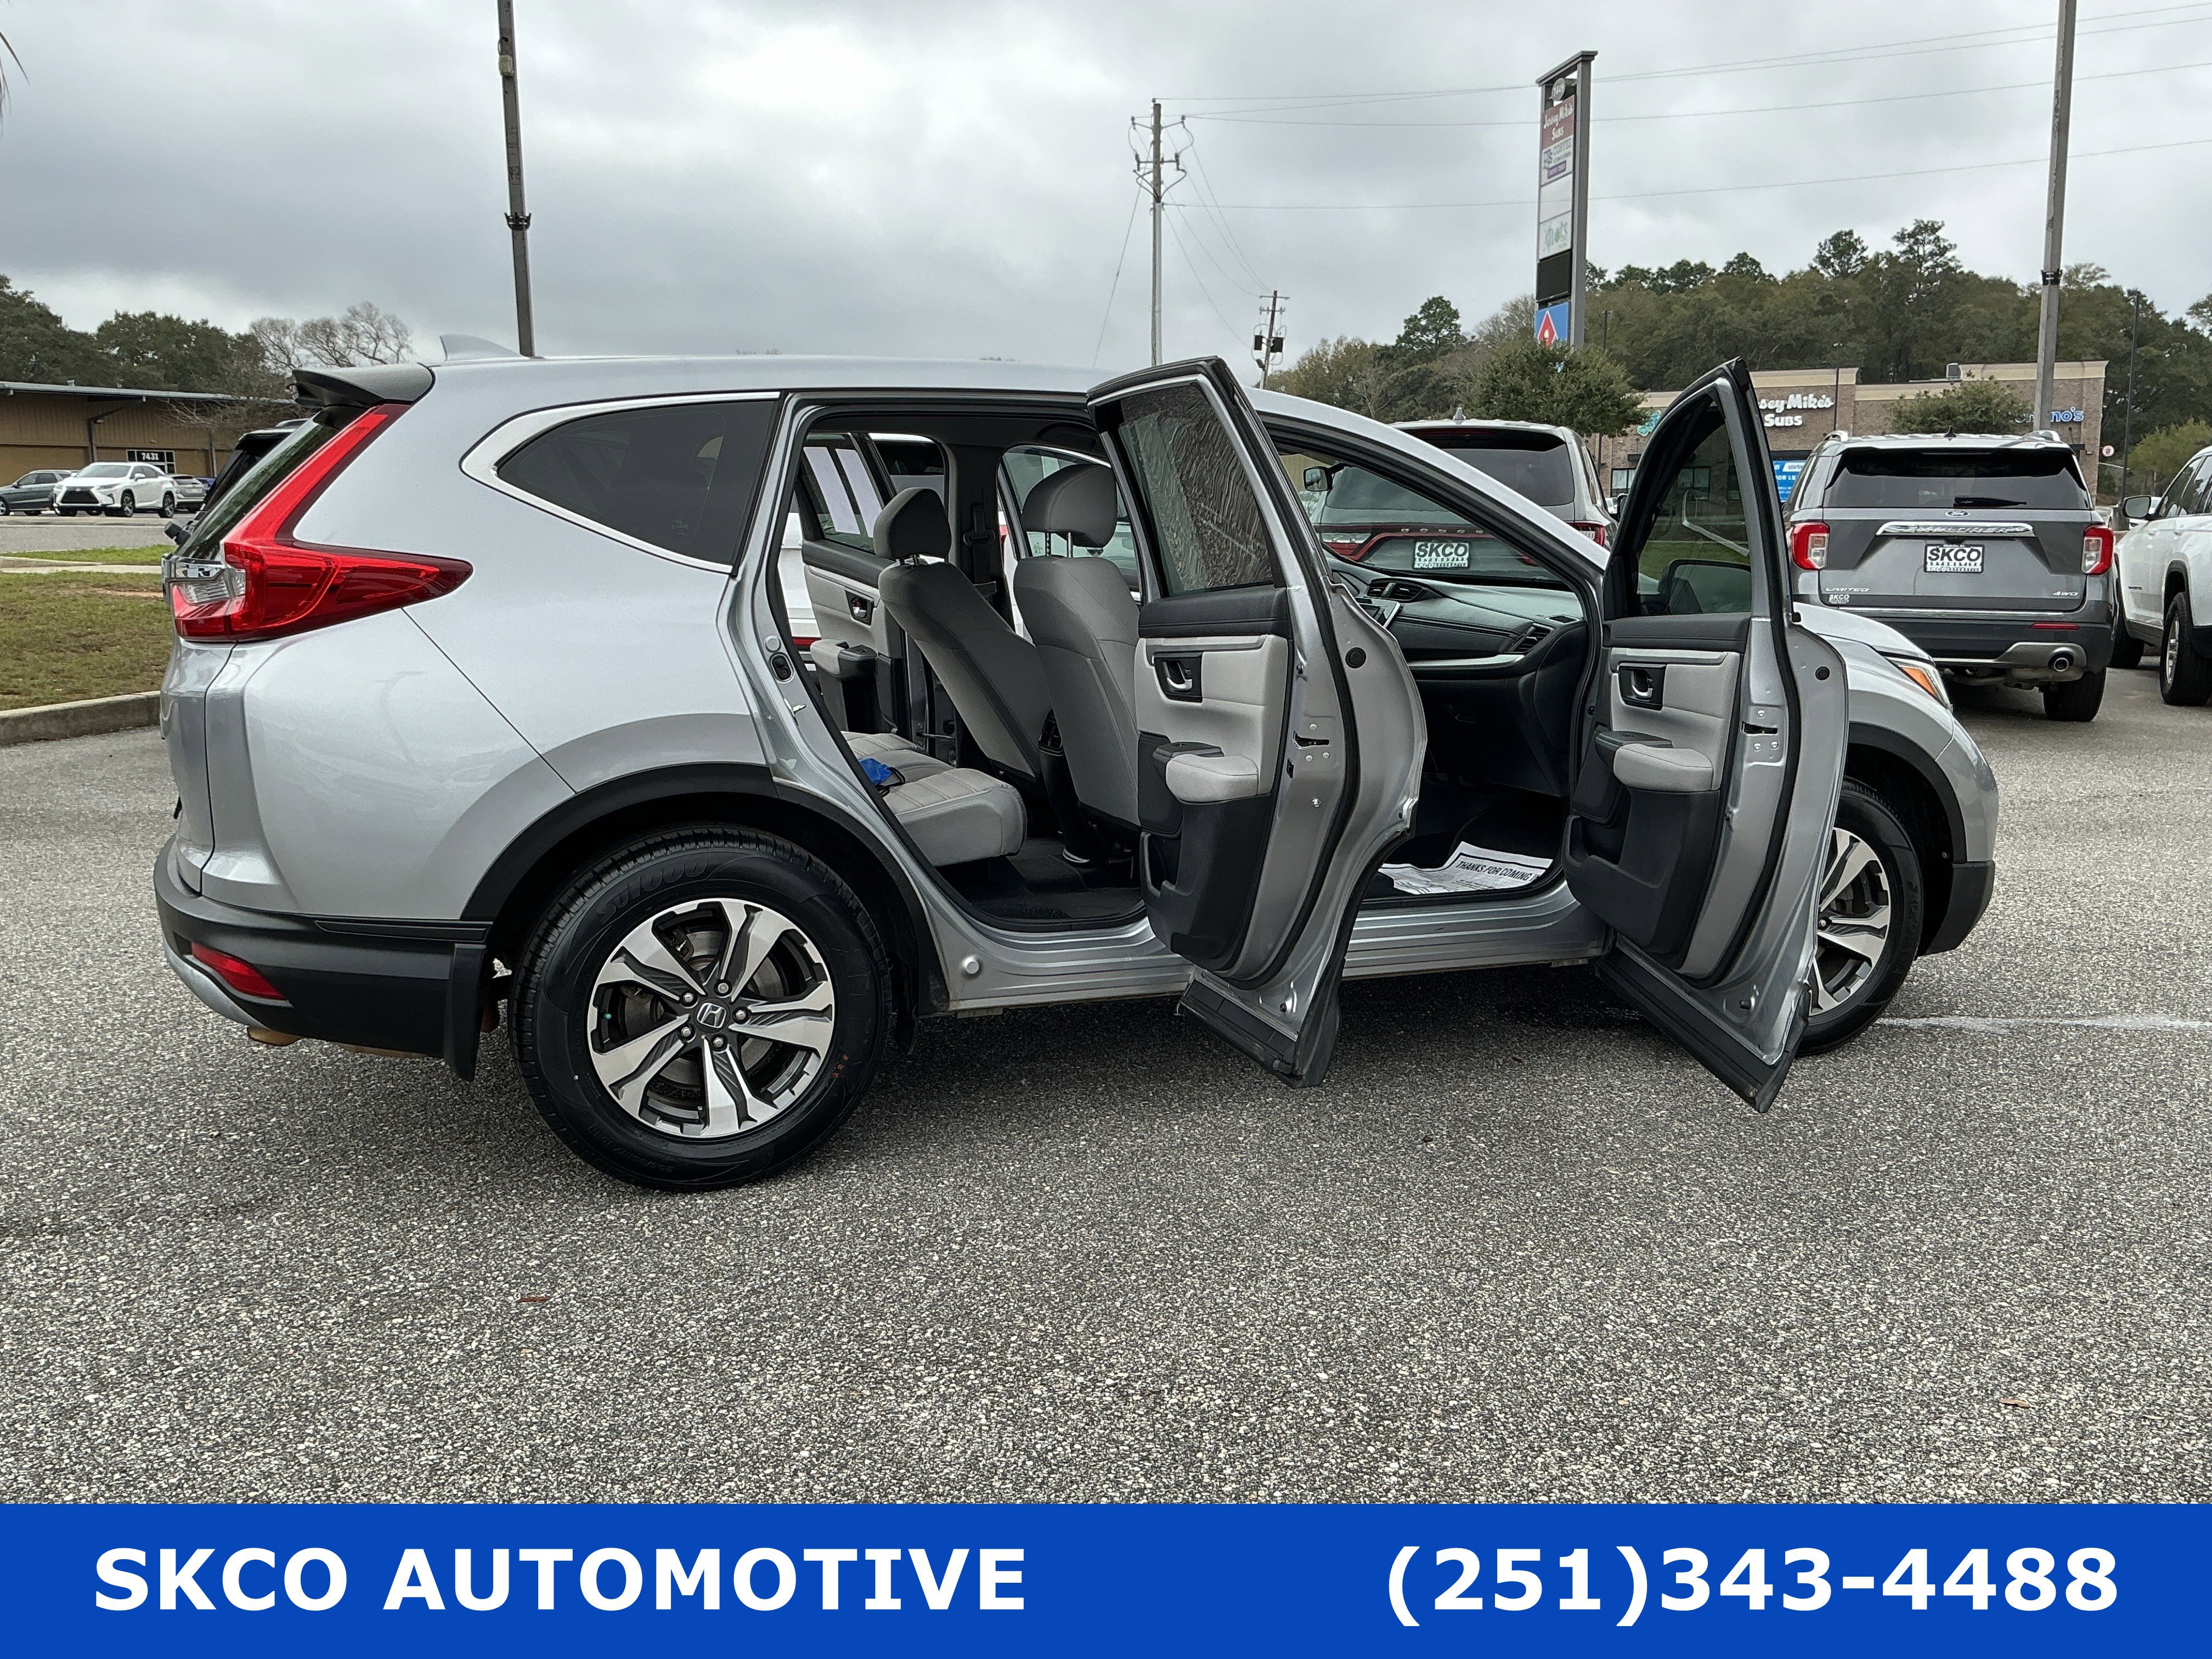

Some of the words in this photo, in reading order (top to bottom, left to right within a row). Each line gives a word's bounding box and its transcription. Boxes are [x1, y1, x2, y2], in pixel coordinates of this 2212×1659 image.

[1786, 393, 1835, 409] Mike's
[141, 452, 160, 461] 7431
[1416, 543, 1469, 557] SKCO
[1927, 548, 1981, 562] SKCO
[1455, 861, 1487, 873] THANKS
[1483, 866, 1502, 875] FOR
[1499, 868, 1532, 881] COMING
